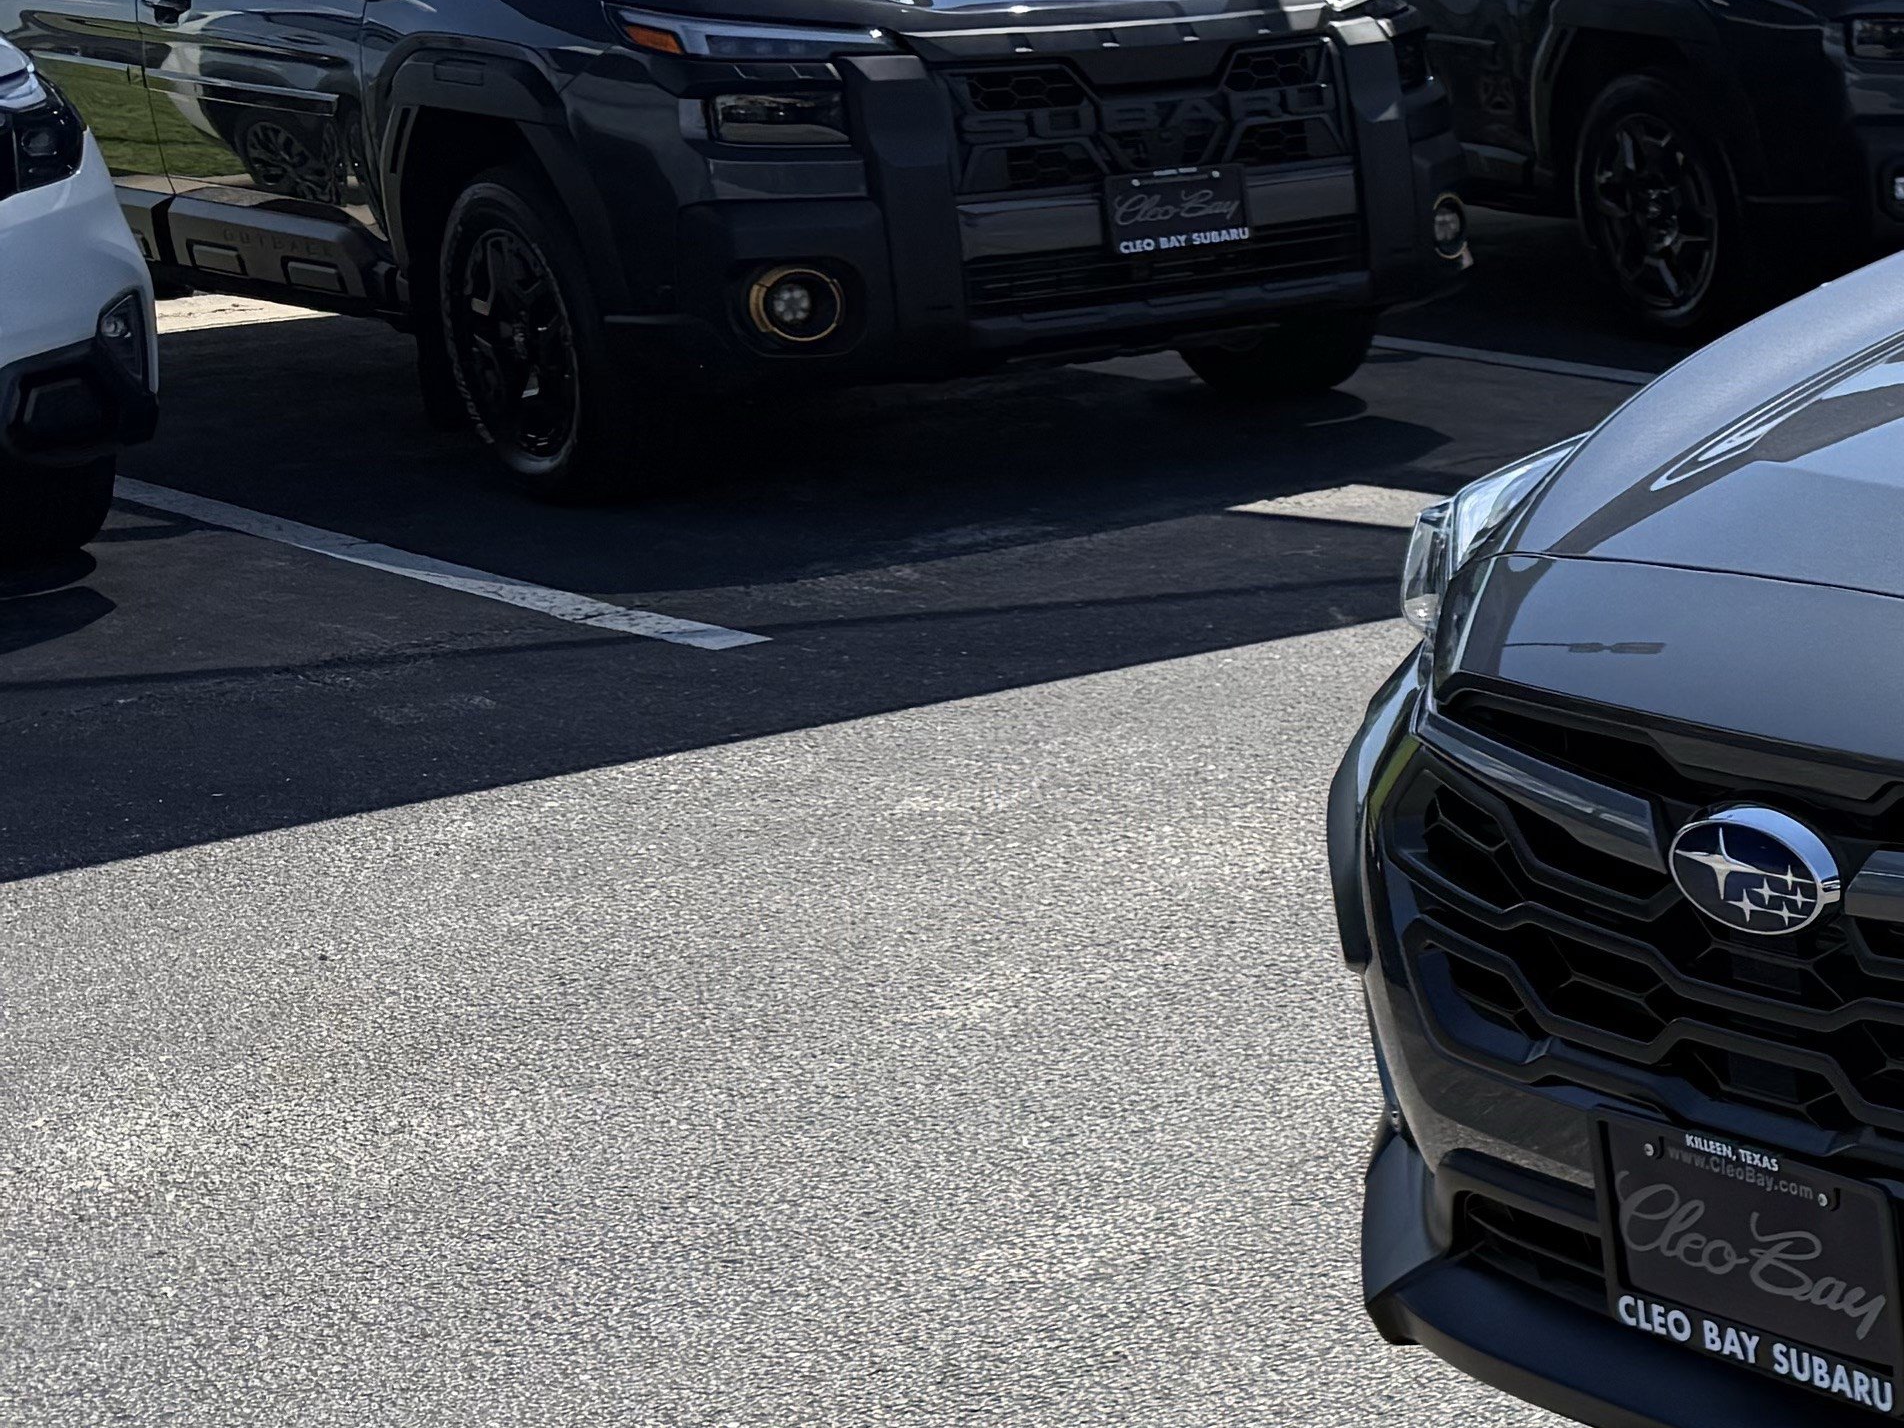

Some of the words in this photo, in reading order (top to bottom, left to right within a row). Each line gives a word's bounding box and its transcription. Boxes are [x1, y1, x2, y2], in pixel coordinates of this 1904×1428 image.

[958, 83, 1332, 143] SUBARU
[1114, 194, 1177, 226] Cleo
[1179, 189, 1241, 220] Bay
[1119, 238, 1155, 254] CLEO
[1158, 234, 1188, 250] BAY
[1191, 227, 1250, 245] SUBARU
[1665, 1146, 1814, 1201] www.CleoBay.com
[1684, 1132, 1737, 1161] KILLEEN,
[1739, 1149, 1779, 1172] TEXAS
[1614, 1170, 1750, 1275] Cleo
[1749, 1212, 1887, 1341] Bay
[1617, 1295, 1692, 1342] CLEO
[1702, 1319, 1760, 1364] BAY
[1772, 1342, 1894, 1413] SUBARU
